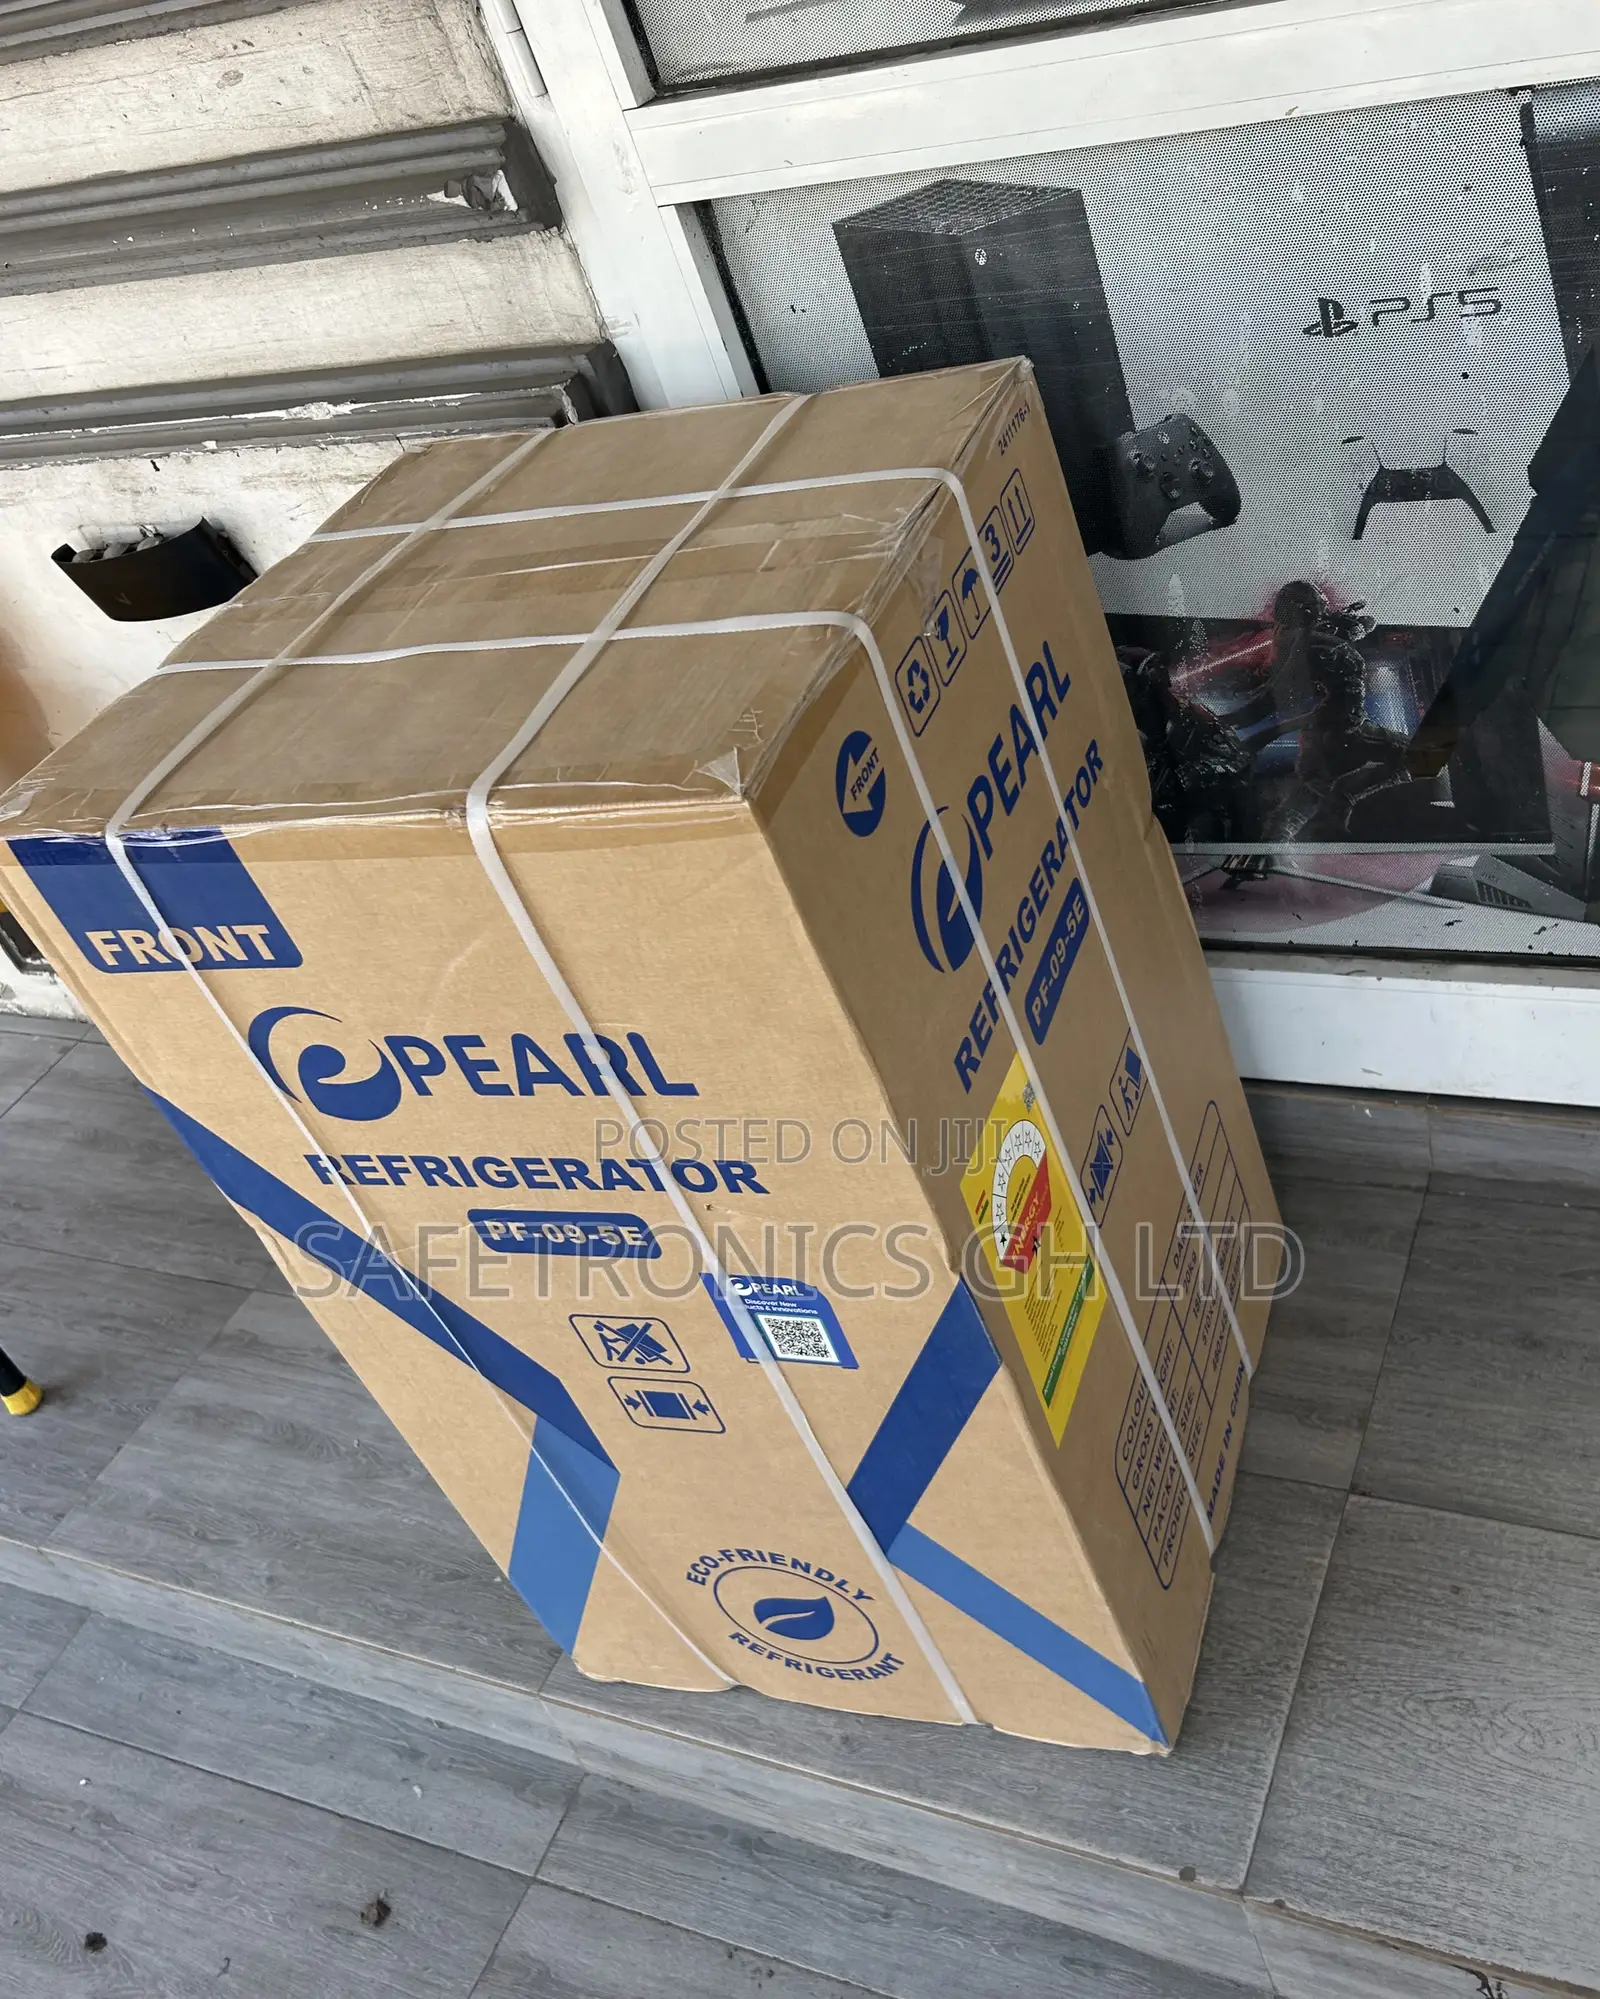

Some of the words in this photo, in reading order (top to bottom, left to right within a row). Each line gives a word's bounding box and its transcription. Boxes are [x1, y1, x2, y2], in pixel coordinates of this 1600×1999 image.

[1370, 287, 1502, 327] PS5
[997, 404, 1031, 456] 2411176-1
[984, 524, 1000, 562] 3
[850, 747, 881, 802] FRONT
[967, 640, 1071, 861] PEARL
[954, 739, 1103, 1094] REFRIGERATOR
[85, 925, 275, 966] FRONT
[1031, 894, 1085, 1027] PF-09-5E
[384, 1032, 700, 1096] PEARL
[303, 1154, 771, 1195] REFRIGERATOR
[1187, 1161, 1204, 1221] SVER
[484, 1220, 648, 1247] PF-09-5E
[744, 1298, 778, 1306] Discover
[751, 1283, 804, 1296] PEARL
[1133, 1419, 1153, 1490] GROSS
[1151, 1337, 1175, 1416] WIGHT:
[1142, 1475, 1156, 1517] NET
[1154, 1388, 1179, 1472] WEIHT:
[1206, 1452, 1225, 1523] MADE
[1223, 1420, 1232, 1449] IN
[1230, 1360, 1246, 1416] CHIN
[1163, 1475, 1188, 1567] PRODUC
[686, 1549, 876, 1601] ECO-FRIENDLY
[729, 1631, 905, 1681] REFRIGERANT
